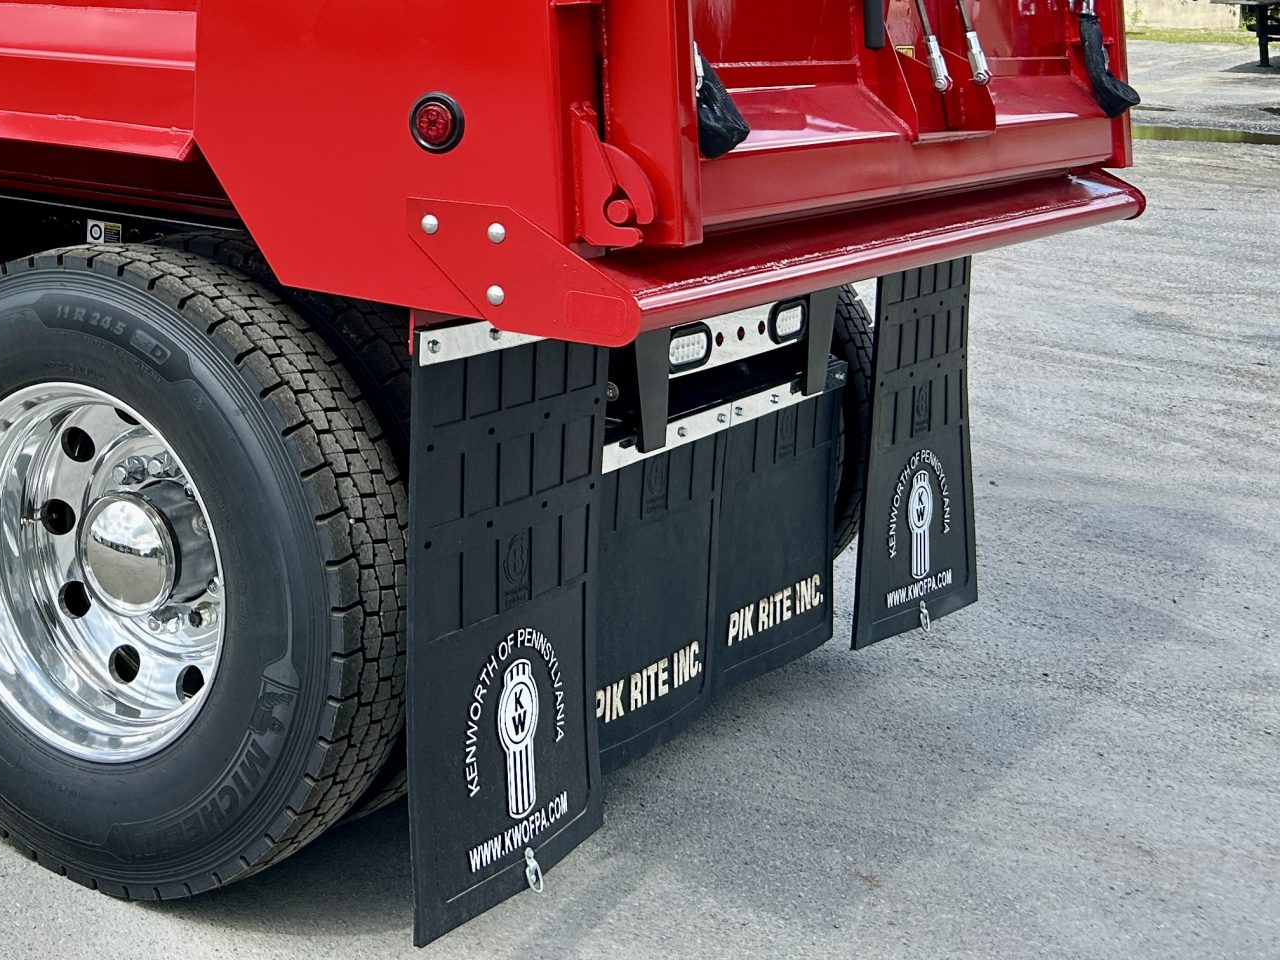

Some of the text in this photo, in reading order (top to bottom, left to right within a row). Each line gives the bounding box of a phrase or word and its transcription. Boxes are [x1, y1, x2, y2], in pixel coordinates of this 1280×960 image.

[889, 449, 951, 559] KENWORTH OF PENNSYLVANIA
[727, 573, 824, 646] PIK RITE INC.
[886, 569, 952, 608] WWW.KWOFPA.COM
[464, 627, 564, 798] KENWORTH OF PENNSYLVANIA
[596, 641, 702, 723] PIK RITE INC.
[468, 790, 568, 873] WWW.KWOFPA.COM
